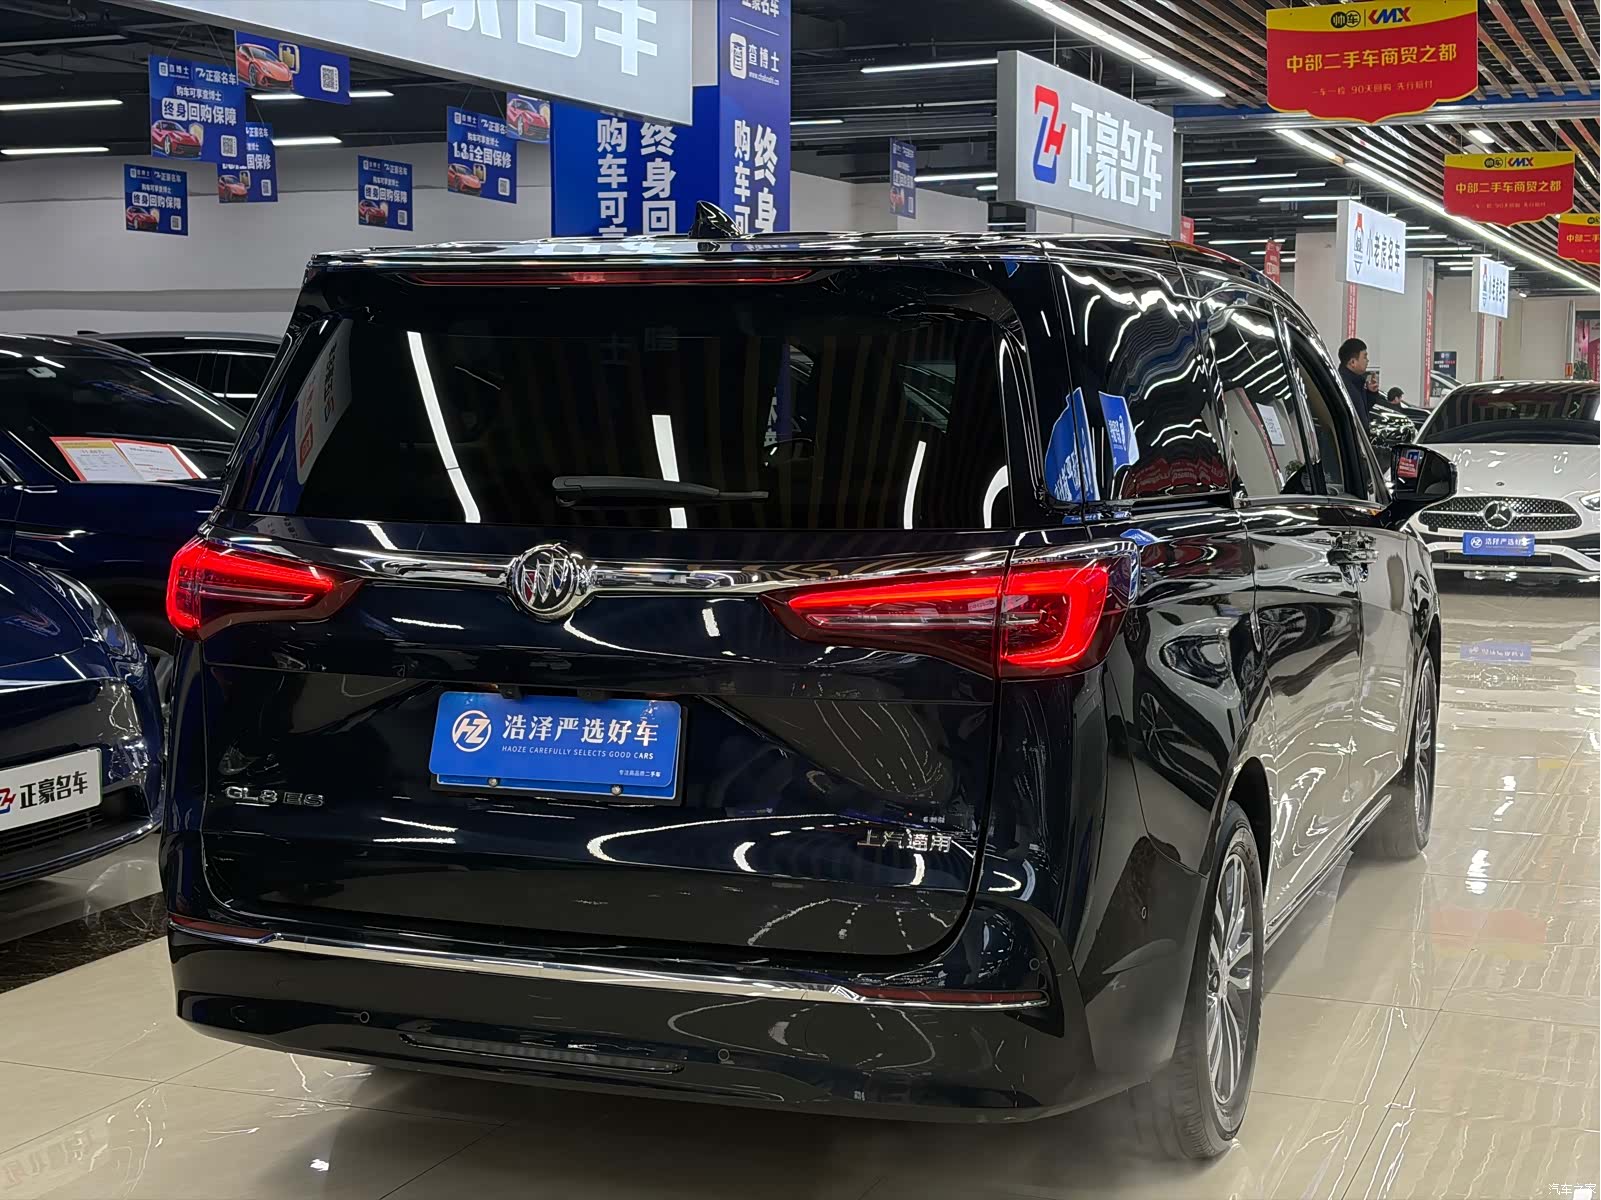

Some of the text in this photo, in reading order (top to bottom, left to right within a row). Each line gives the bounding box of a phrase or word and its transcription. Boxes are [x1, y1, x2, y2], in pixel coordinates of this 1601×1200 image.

[749, 44, 780, 73] 查博士
[1286, 43, 1457, 74] 中部二手车商贸之都
[205, 69, 237, 86] 正豪名车
[162, 98, 237, 127] 终身回购保障
[1069, 102, 1163, 212] 正豪名车
[640, 121, 678, 235] 终身回
[1456, 180, 1562, 195] 中部二手车商贸之都
[502, 714, 659, 747] 浩泽严选好车
[502, 745, 654, 760] HAOZE CAREFULLY SELECTS GOOD CARS
[20, 770, 88, 810] 正豪名车
[224, 786, 325, 807] GL8 ES
